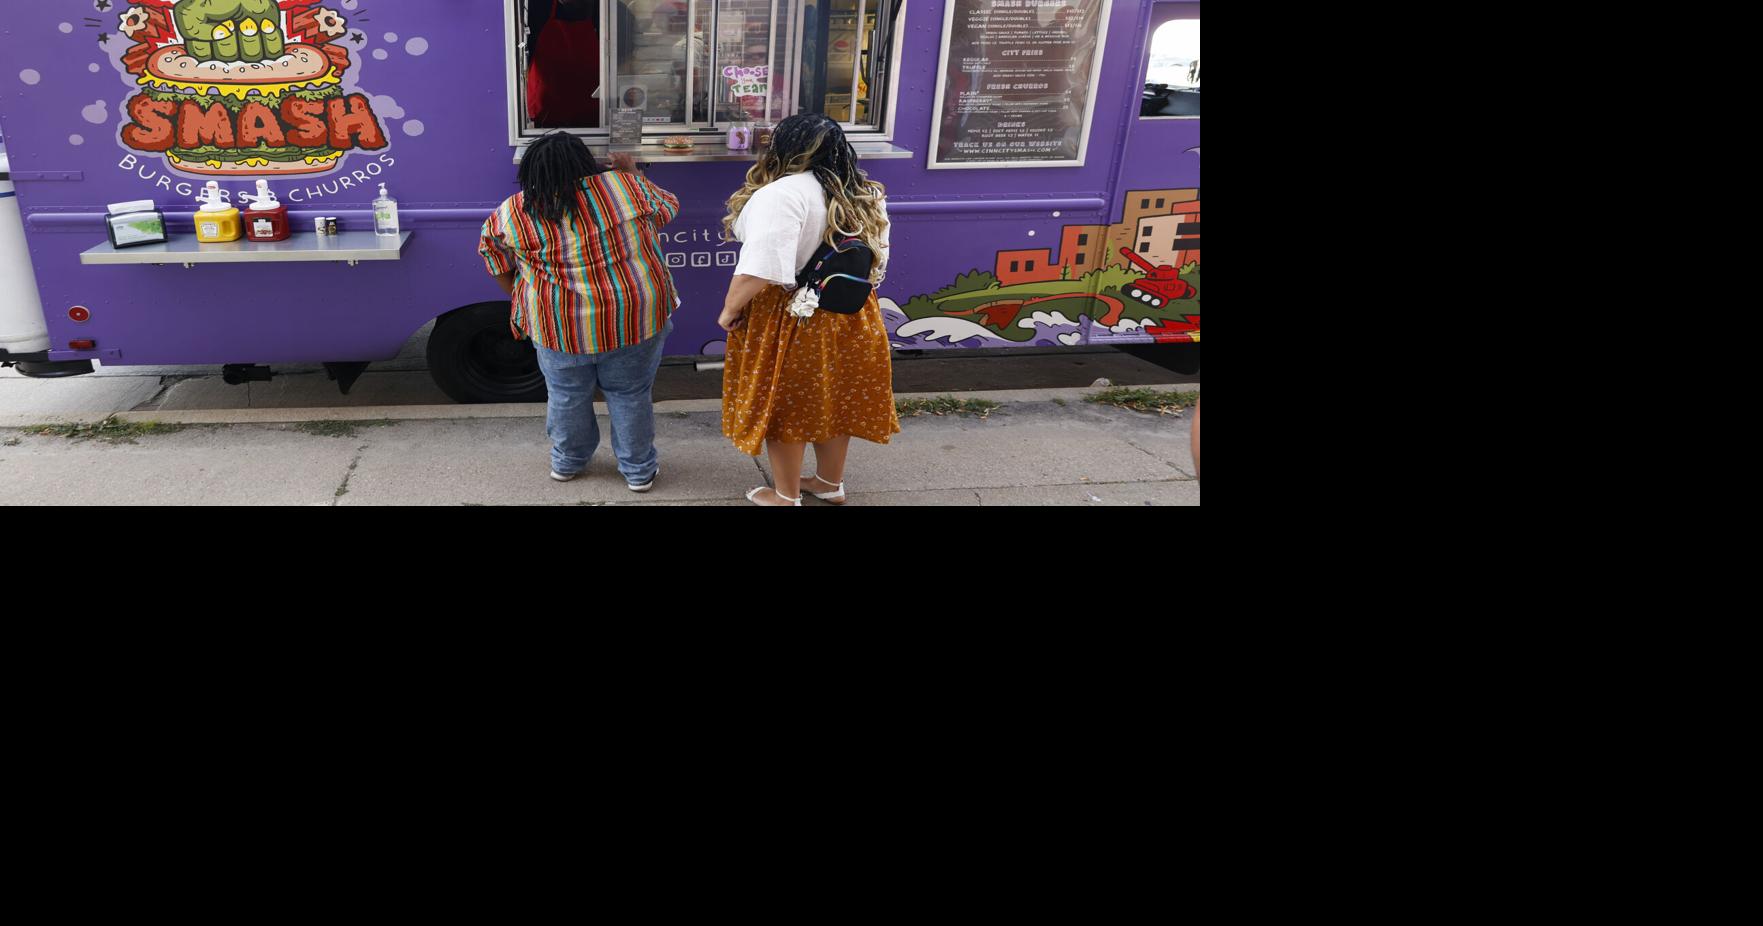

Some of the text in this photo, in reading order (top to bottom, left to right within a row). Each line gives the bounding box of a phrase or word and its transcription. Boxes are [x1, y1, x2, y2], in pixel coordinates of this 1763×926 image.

[121, 93, 389, 150] SMASH
[118, 154, 249, 204] BURGERS
[288, 153, 395, 203] CHURROS
[658, 229, 727, 246] ncity
